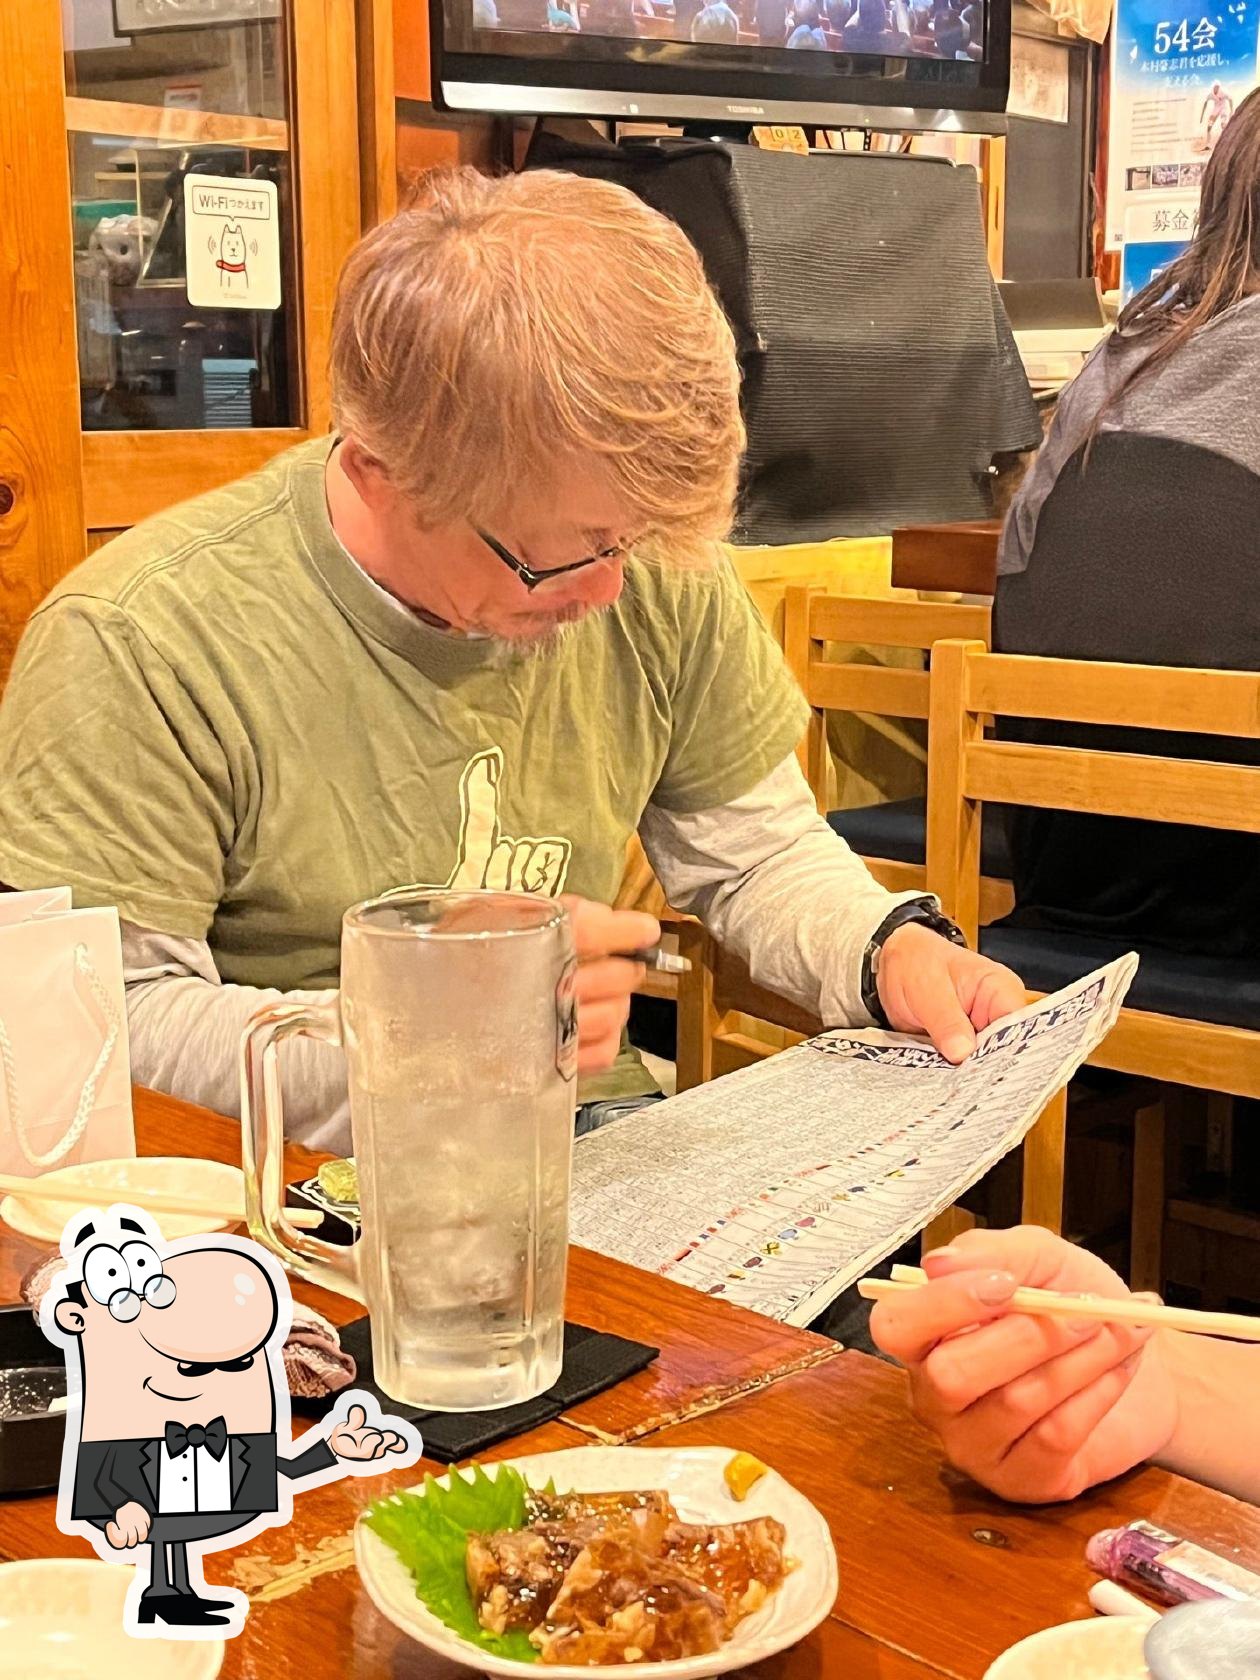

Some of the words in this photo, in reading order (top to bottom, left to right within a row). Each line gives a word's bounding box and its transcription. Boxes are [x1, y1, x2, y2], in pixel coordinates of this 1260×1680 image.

[1154, 17, 1218, 54] 54会
[725, 105, 765, 115] TOSHIBA
[199, 193, 264, 212] Wi-Fiつかえます
